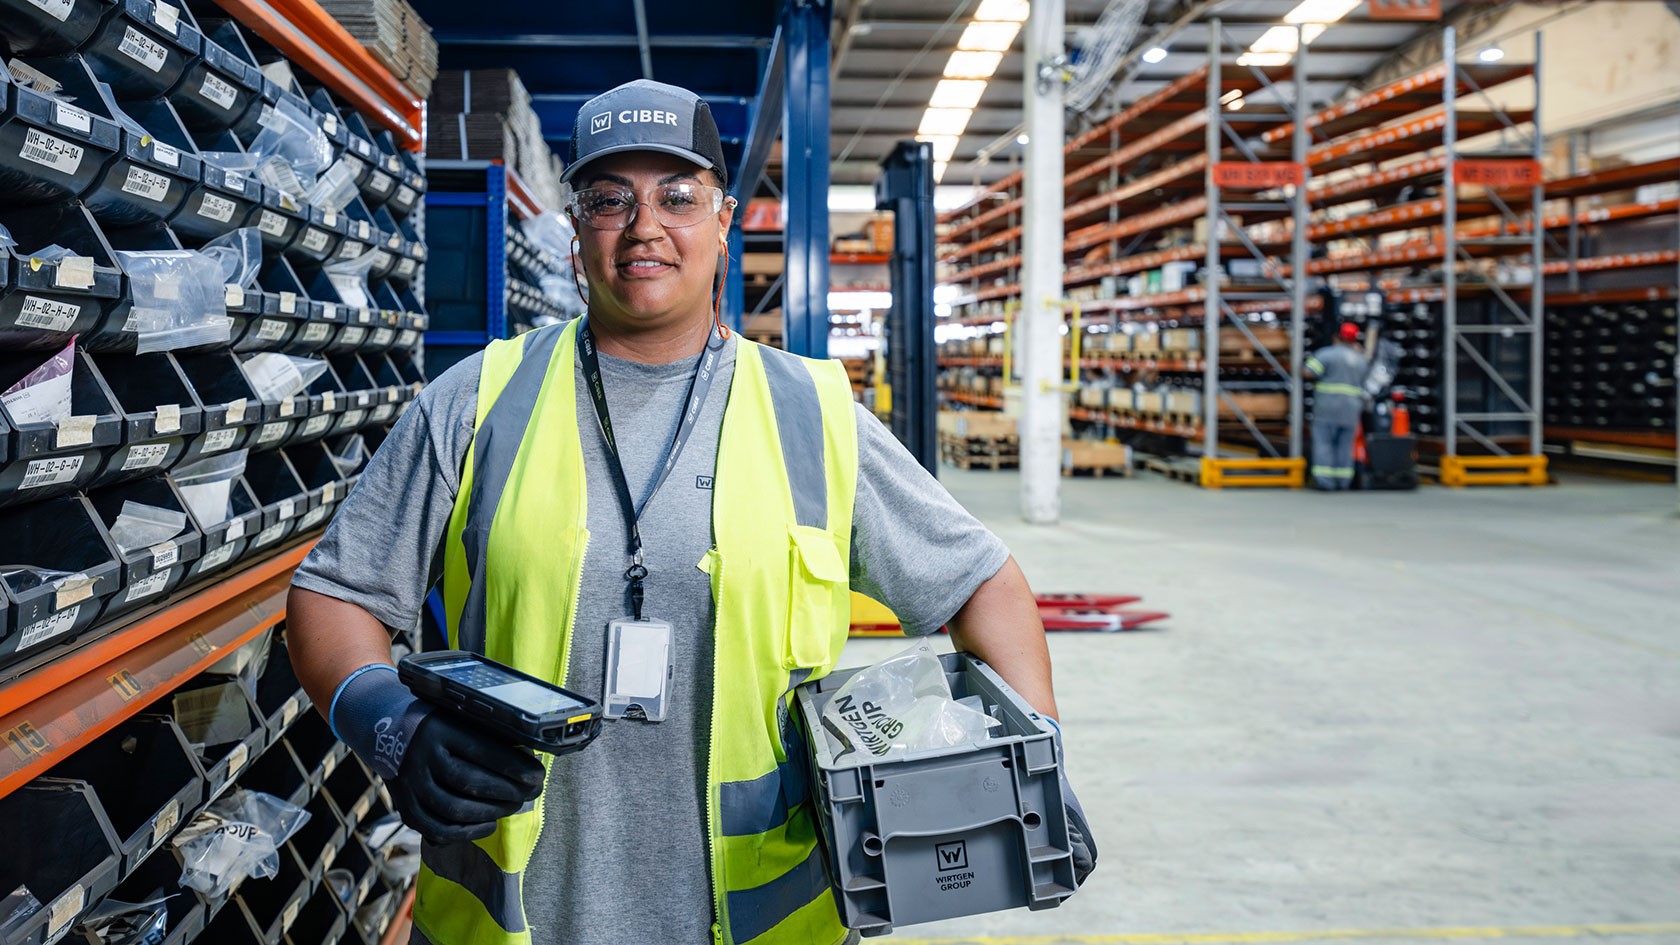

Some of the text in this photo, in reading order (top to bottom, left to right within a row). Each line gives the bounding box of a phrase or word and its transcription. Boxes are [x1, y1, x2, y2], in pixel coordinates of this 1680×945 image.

[618, 109, 678, 127] CIBER
[27, 130, 79, 160] WH-02-J-04
[128, 168, 167, 190] WH-02-J-05
[23, 299, 77, 319] WH-02-H-04
[27, 458, 80, 475] WH-02-G-04
[111, 670, 142, 697] 16
[834, 694, 891, 757] WIRTGEN
[7, 722, 47, 755] 15
[935, 872, 975, 884] WIRTGEN
[940, 880, 971, 891] GROUP
